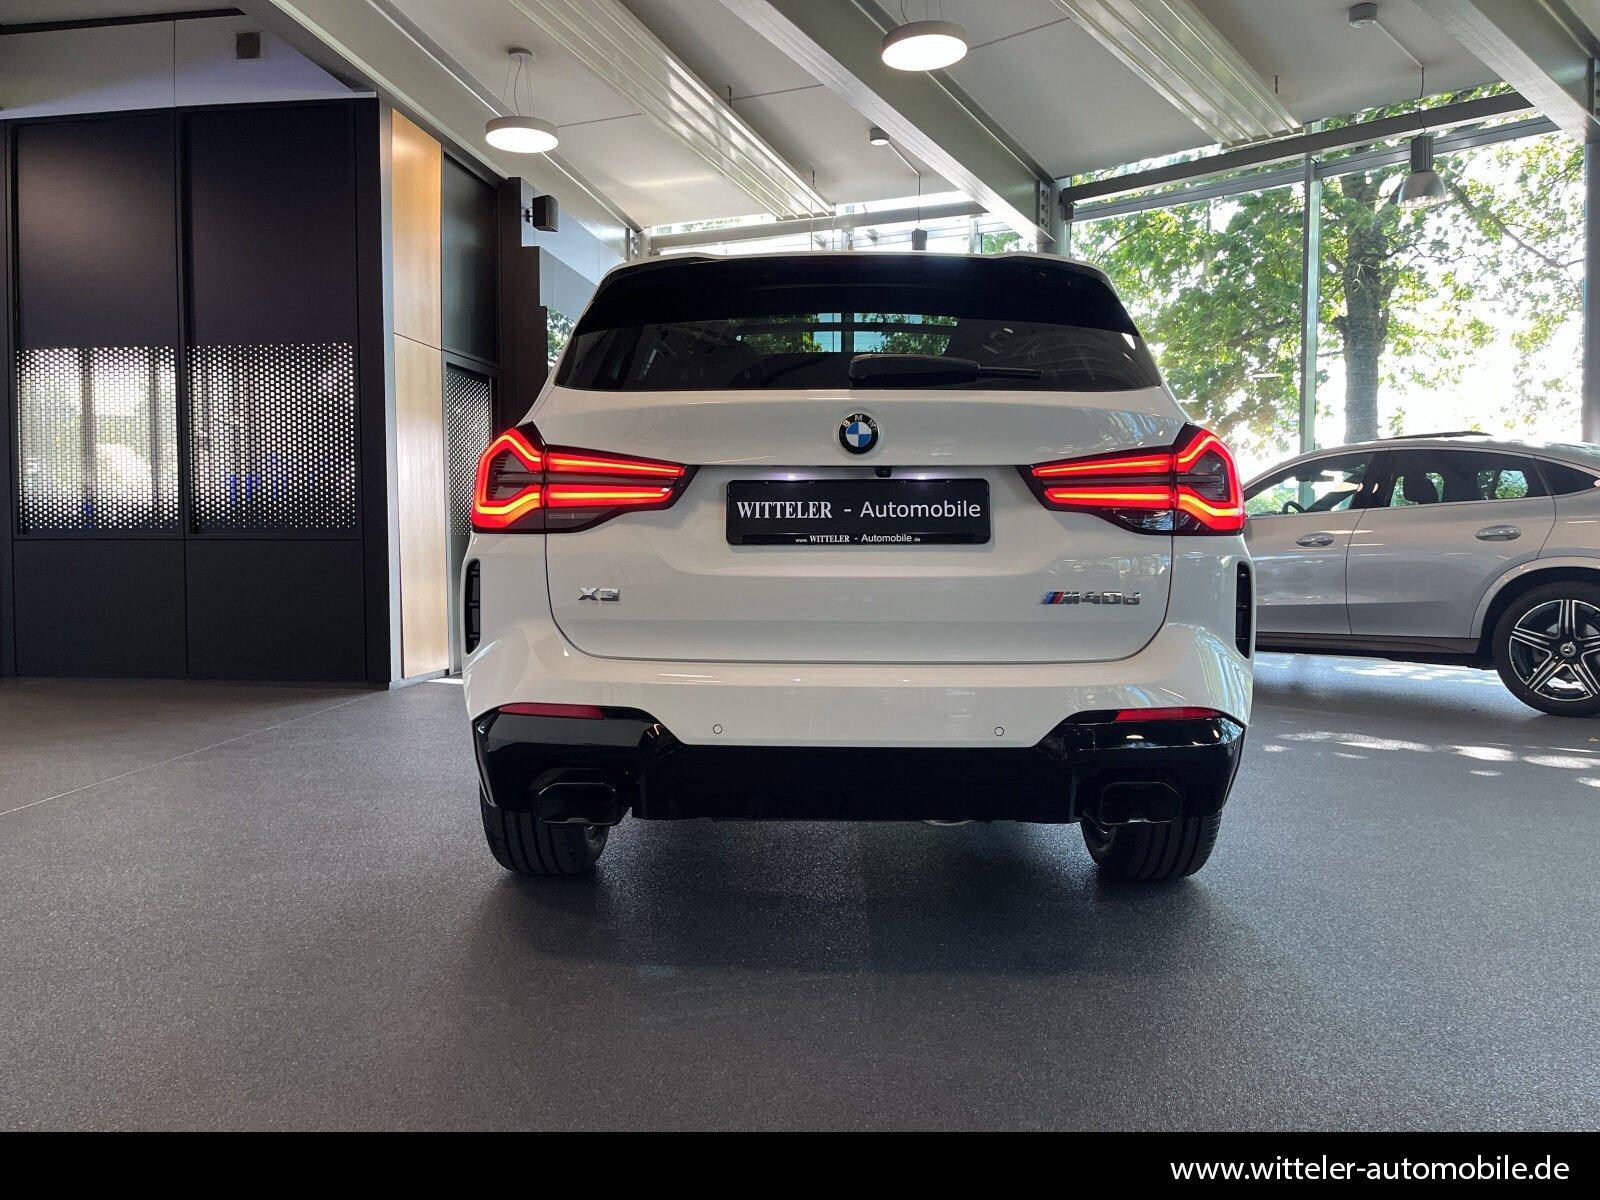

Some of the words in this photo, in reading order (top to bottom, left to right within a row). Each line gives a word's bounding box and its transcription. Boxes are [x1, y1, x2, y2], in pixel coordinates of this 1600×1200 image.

[737, 501, 833, 519] WITTELER
[859, 500, 981, 518] Automobile
[809, 534, 850, 543] WITTELER
[861, 533, 912, 543] Automobile
[578, 587, 619, 601] X3
